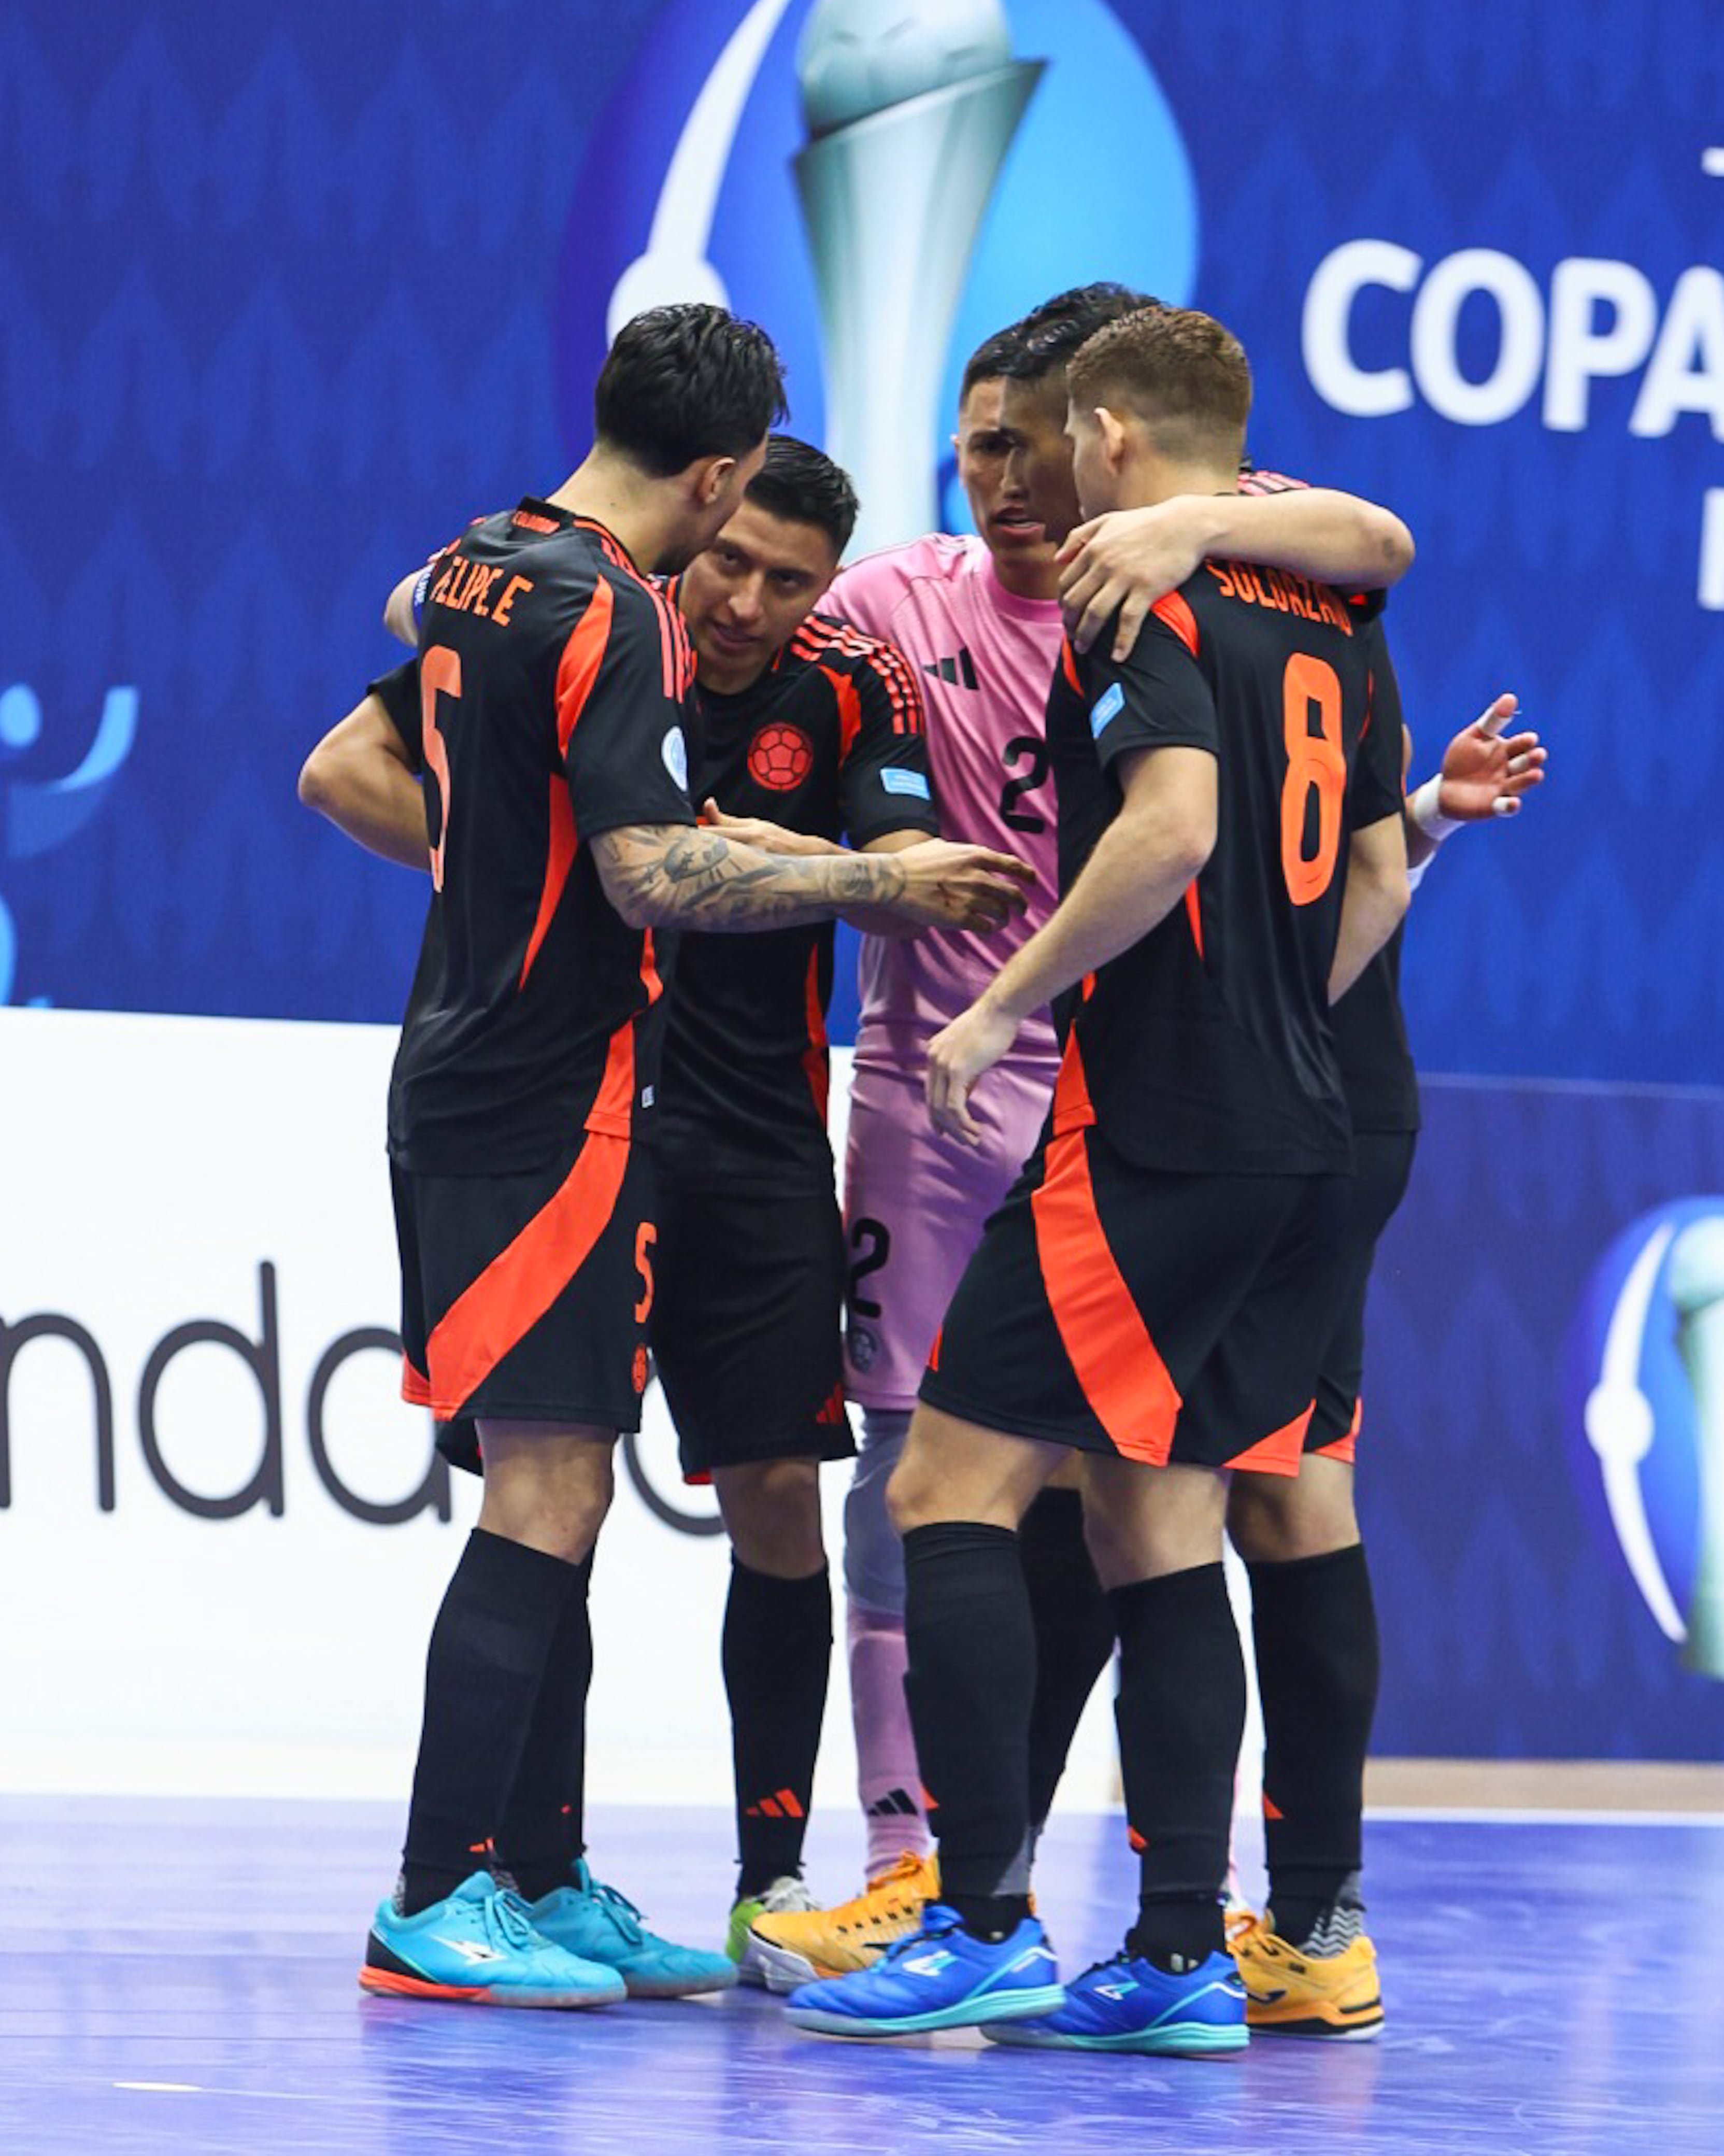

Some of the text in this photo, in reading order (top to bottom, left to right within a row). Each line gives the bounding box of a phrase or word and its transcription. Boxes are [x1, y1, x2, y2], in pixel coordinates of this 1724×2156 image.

[1302, 238, 1724, 443] COPA
[420, 644, 462, 892] 5
[999, 737, 1048, 834] 2
[1280, 651, 1347, 906] 8
[634, 1221, 657, 1324] 5
[851, 1217, 891, 1319] 2
